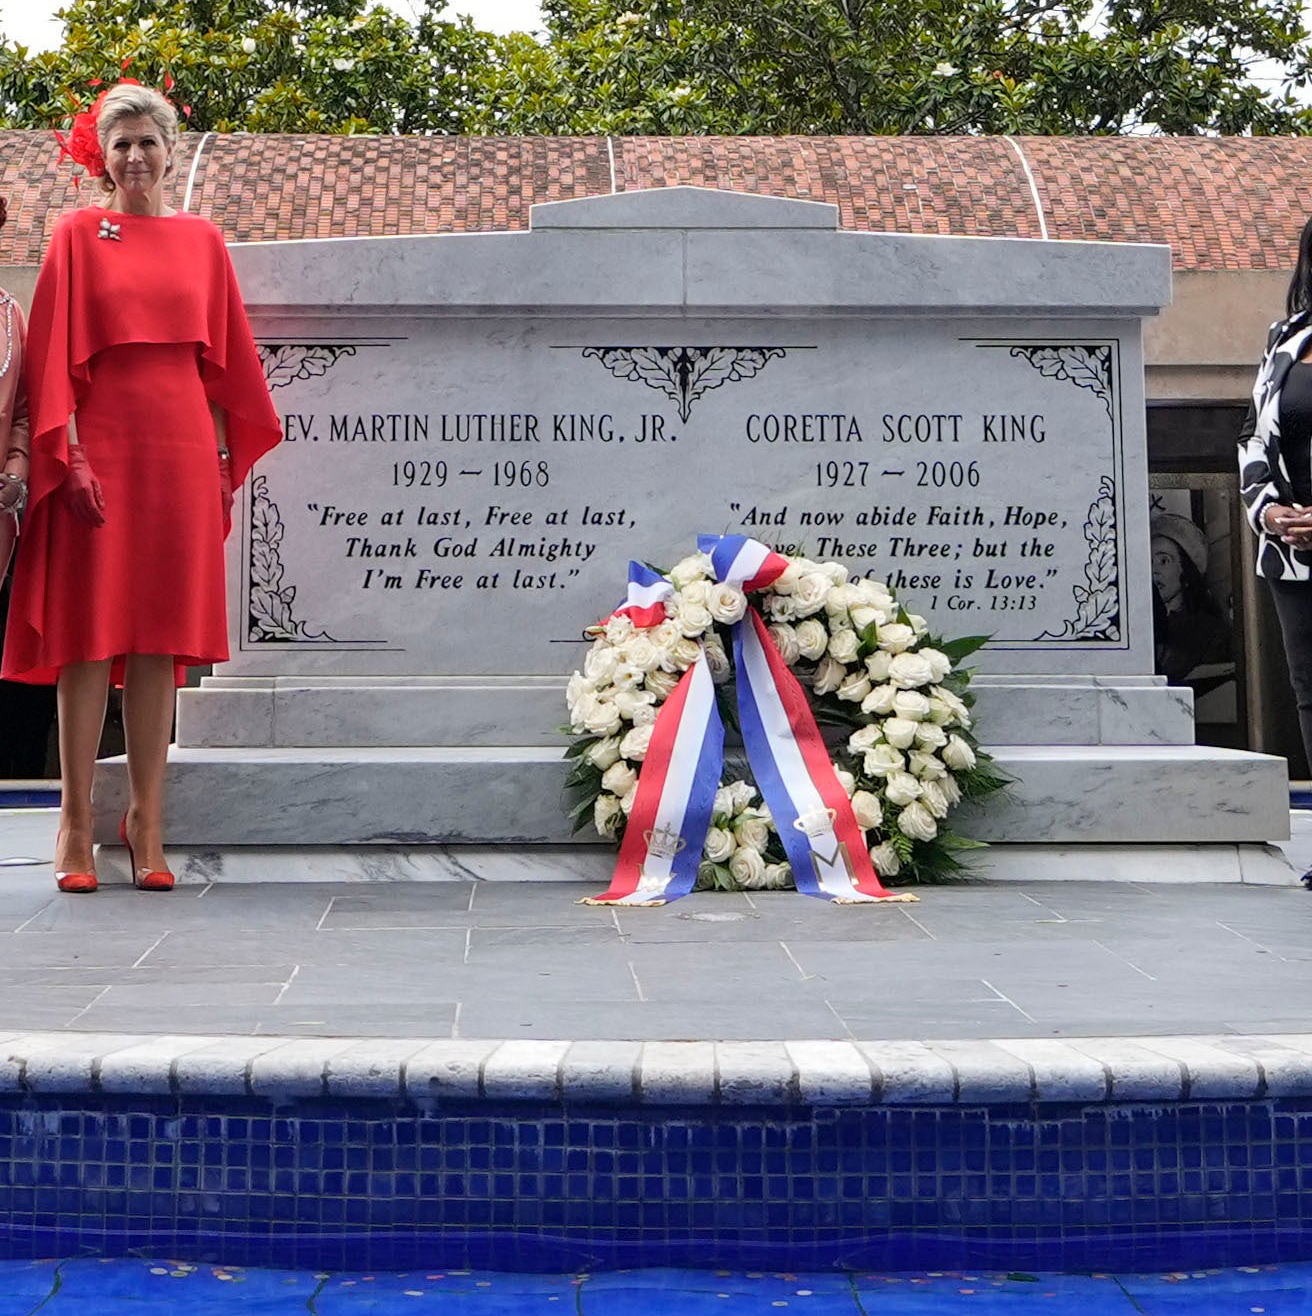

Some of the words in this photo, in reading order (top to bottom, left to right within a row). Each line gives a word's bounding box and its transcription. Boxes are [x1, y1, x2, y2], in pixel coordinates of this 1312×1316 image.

[283, 414, 319, 442] EV.
[329, 414, 429, 443] MARTIN
[440, 414, 541, 443] LUTHER
[552, 414, 626, 444] KING,
[634, 414, 678, 443] JR.
[745, 413, 864, 444] CORETTA
[882, 413, 963, 444] SCOTT
[982, 414, 1047, 444] KING
[392, 460, 448, 488] 1929
[493, 460, 550, 488] 1968
[816, 460, 870, 488] 1927
[916, 460, 981, 488] 2006
[307, 503, 369, 526] “Free
[380, 508, 405, 526] at
[416, 505, 471, 529] last,
[484, 505, 533, 526] Free
[544, 508, 569, 526] at
[581, 505, 636, 529] last,
[729, 503, 787, 527] “And
[799, 511, 845, 526] now
[855, 505, 918, 527] abide
[925, 505, 995, 528] Faith,
[1002, 505, 1068, 529] Hope,
[345, 537, 418, 558] Thank
[433, 536, 479, 558] God
[488, 536, 596, 563] Almighty
[816, 537, 878, 558] These
[888, 537, 963, 561] Three;
[972, 537, 1008, 558] but
[1019, 537, 1055, 558] the
[361, 569, 403, 590] I’m
[414, 569, 464, 590] Free
[476, 572, 500, 590] at
[512, 569, 580, 590] last.”
[886, 569, 942, 589] these
[953, 569, 974, 589] is
[984, 569, 1058, 589] Love.”
[930, 595, 938, 611] 1
[946, 595, 981, 611] Cor.
[989, 595, 1037, 611] 13:13
